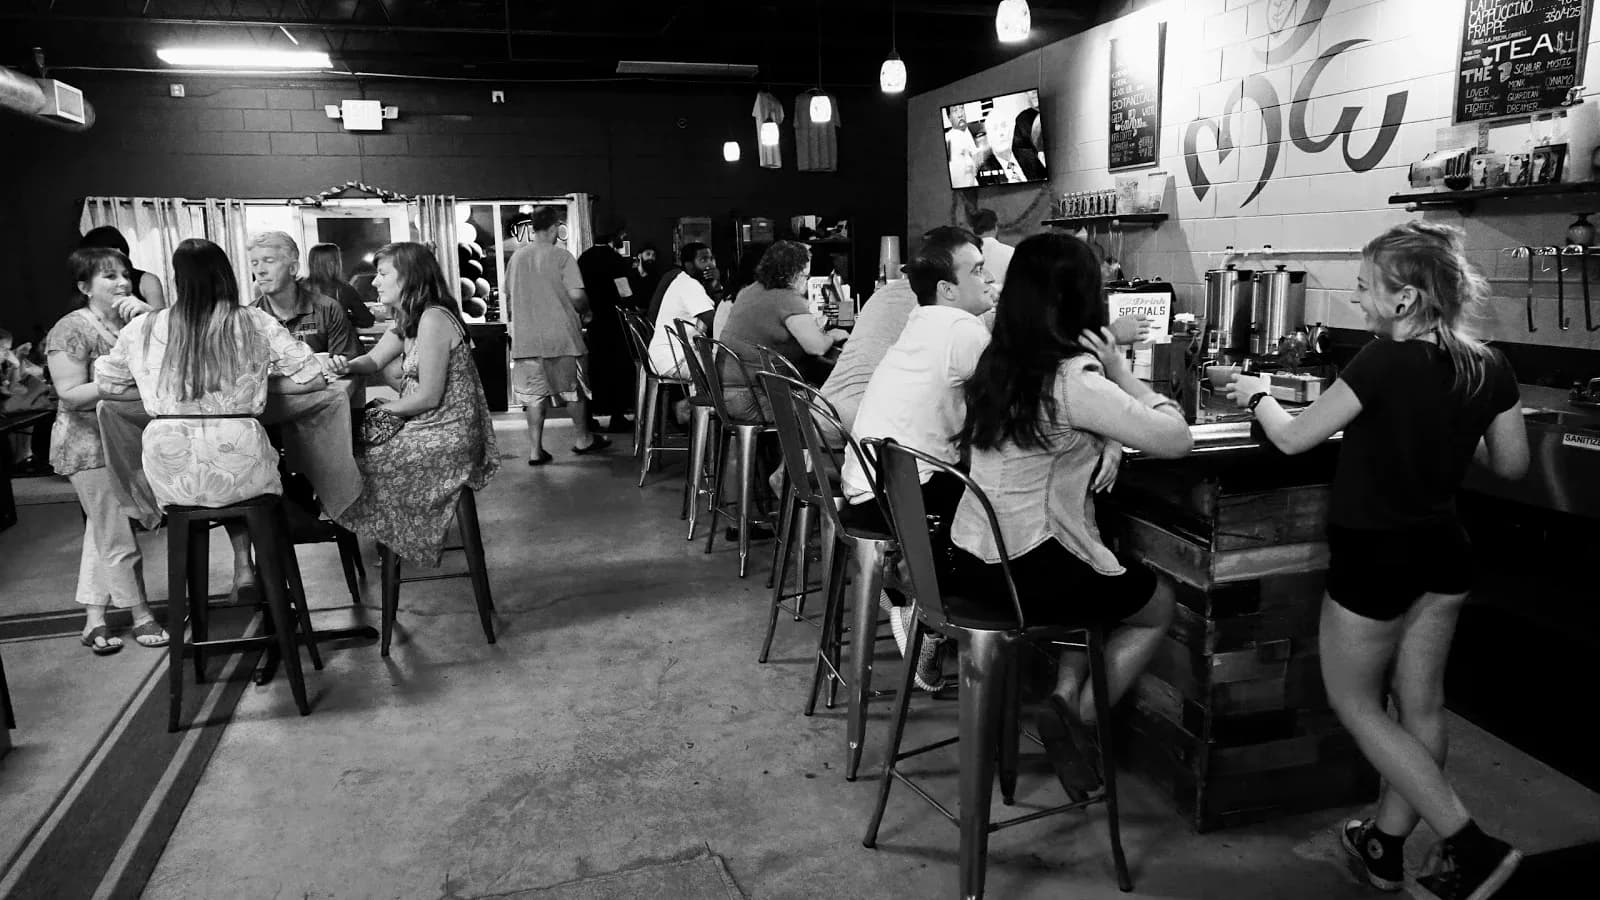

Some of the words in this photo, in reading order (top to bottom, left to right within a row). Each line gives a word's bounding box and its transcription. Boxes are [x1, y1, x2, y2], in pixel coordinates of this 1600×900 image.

[1468, 0, 1534, 27] CAPPUCCINO
[1467, 20, 1506, 40] FRAPPE
[1487, 33, 1554, 62] TEA
[1514, 61, 1542, 75] SCHOLAR
[1546, 57, 1572, 69] MYSTIC
[1461, 65, 1494, 84] THE
[1508, 78, 1526, 89] MONK
[1545, 74, 1574, 88] DYNAMO
[1466, 87, 1489, 98] LOVER
[1507, 90, 1539, 102] GUARDIAN
[1464, 102, 1494, 114] FIGHTER
[1507, 102, 1539, 114] DREAMER
[1118, 306, 1166, 316] SPECIALS
